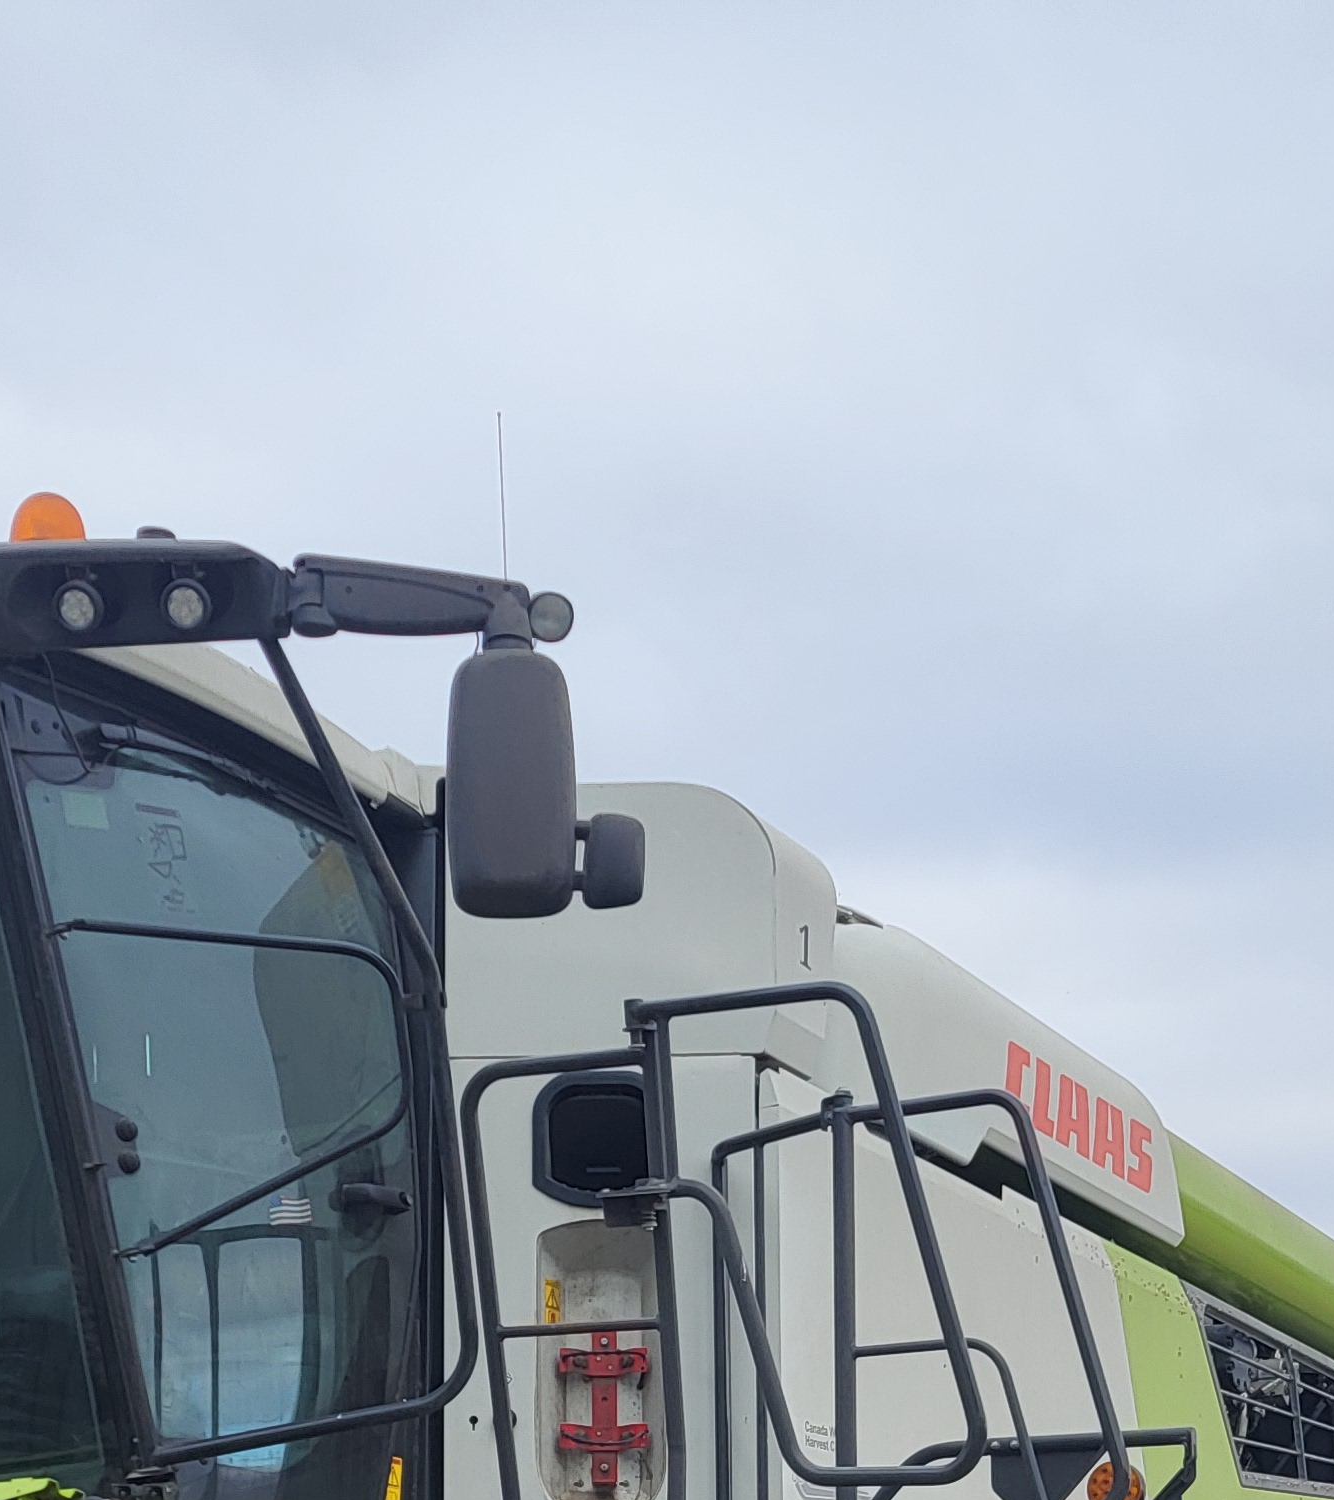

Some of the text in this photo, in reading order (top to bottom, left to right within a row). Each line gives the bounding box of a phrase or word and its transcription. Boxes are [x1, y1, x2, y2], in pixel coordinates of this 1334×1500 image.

[1005, 1040, 1153, 1193] CLAAS
[804, 1420, 829, 1437] Canada
[804, 1434, 829, 1451] Harvest
